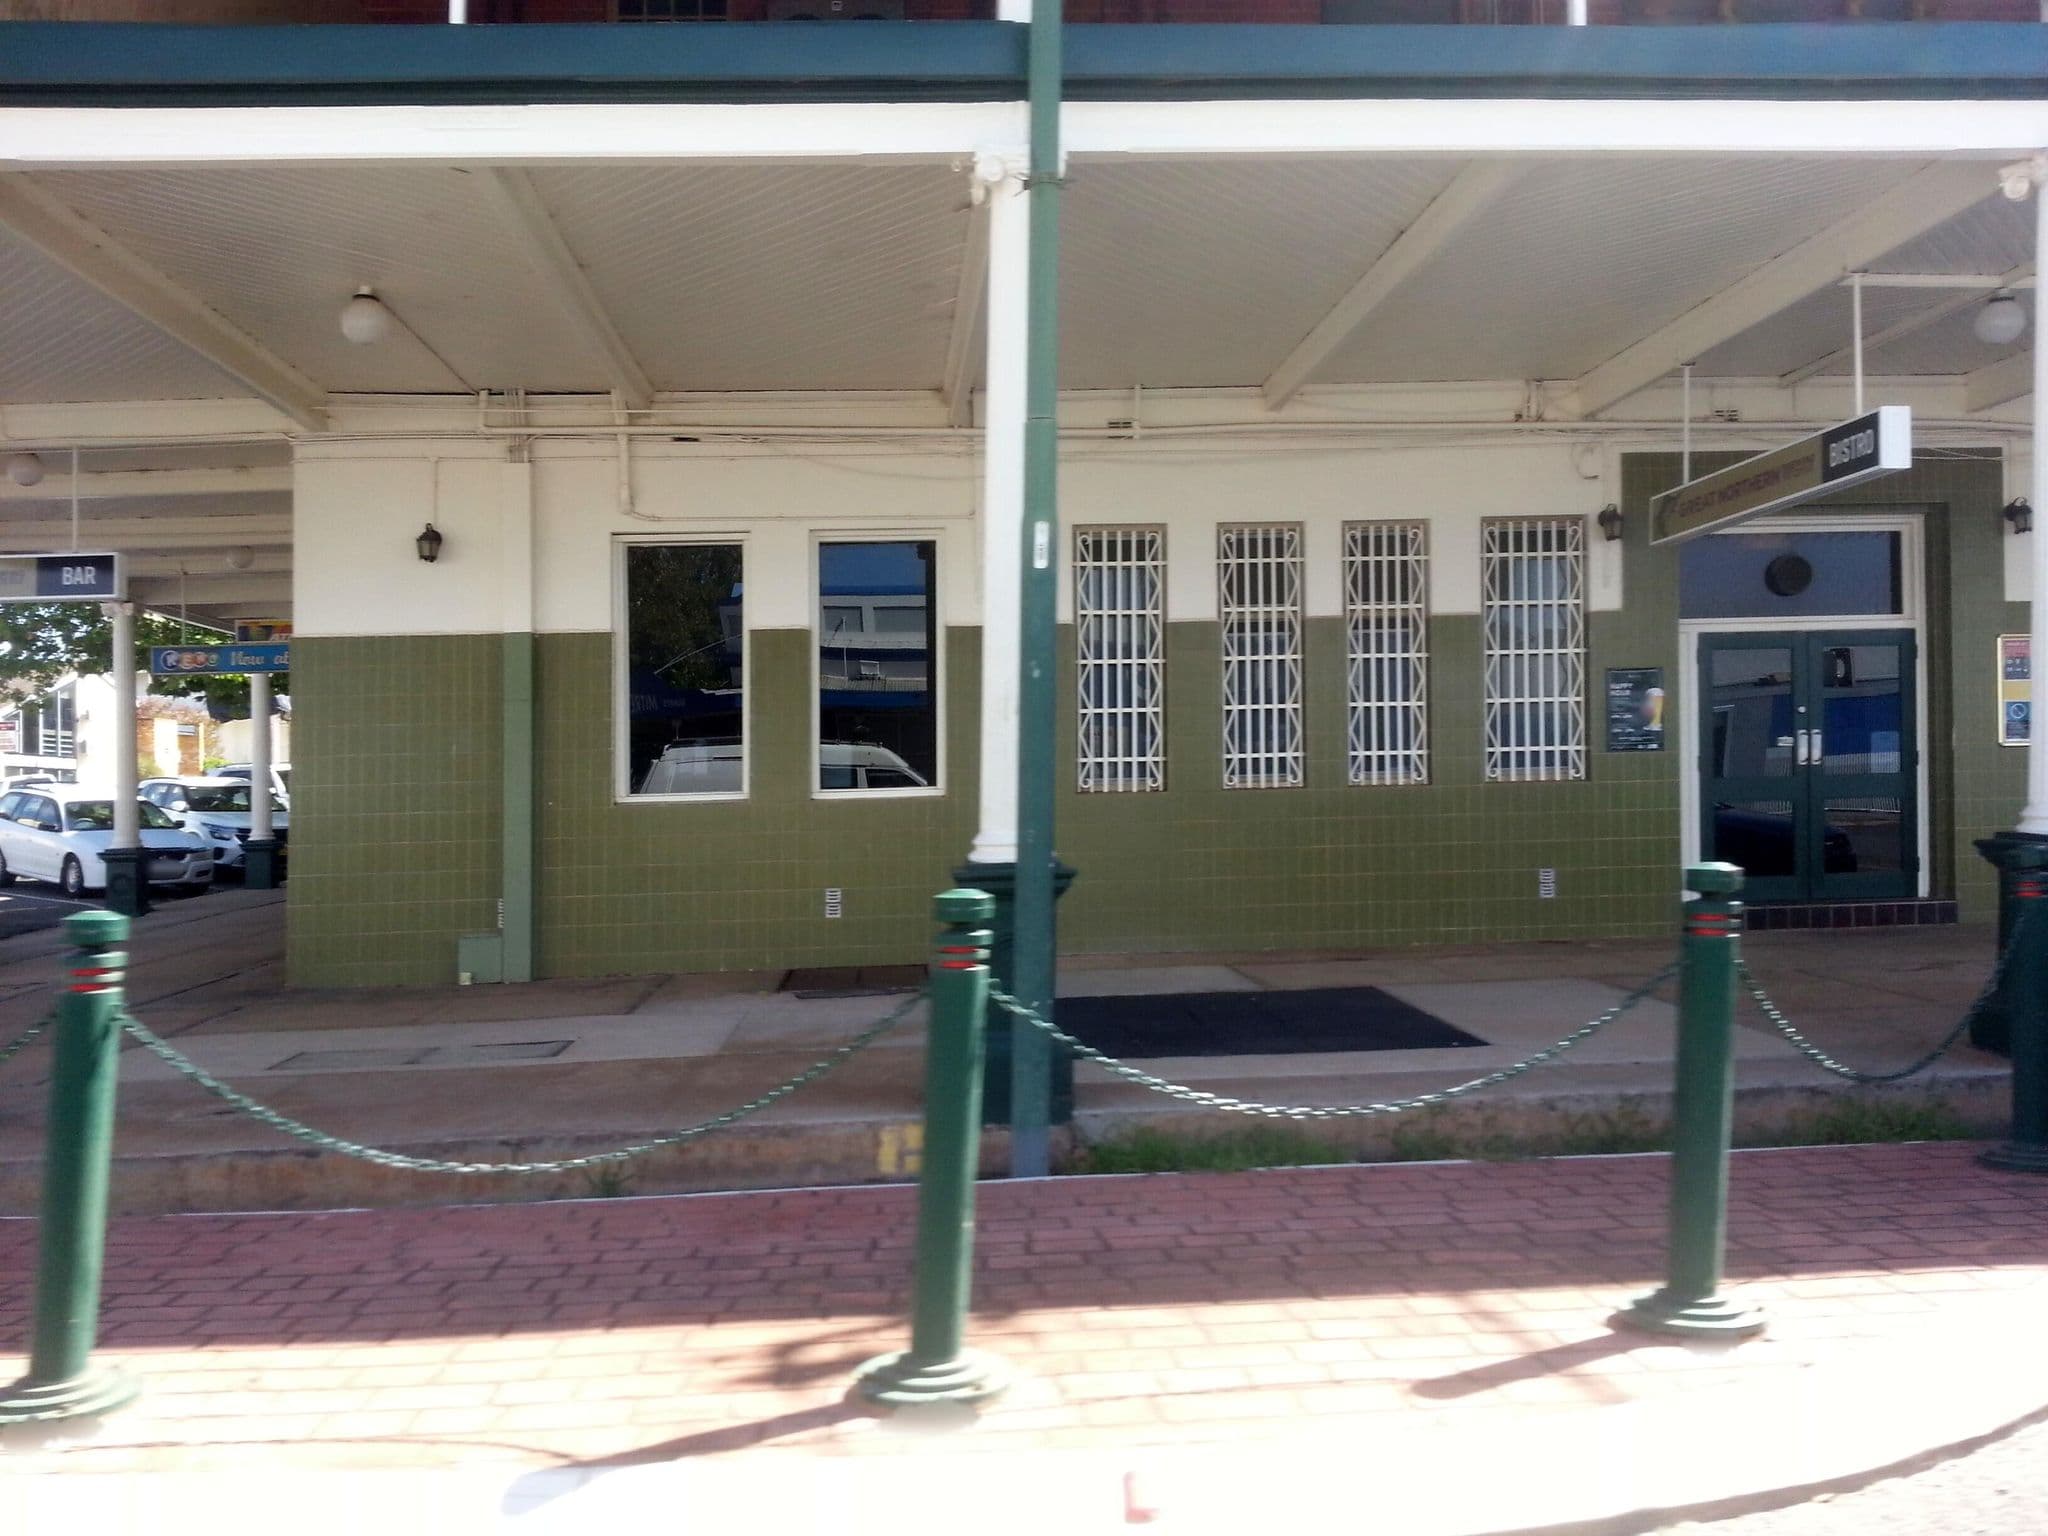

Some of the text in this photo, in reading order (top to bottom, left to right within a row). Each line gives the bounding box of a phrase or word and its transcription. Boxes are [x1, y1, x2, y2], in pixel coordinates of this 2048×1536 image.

[1829, 429, 1874, 467] BISTRO
[1679, 492, 1716, 516] GREAT
[1717, 469, 1780, 502] NORTHERN
[61, 566, 97, 585] BAR
